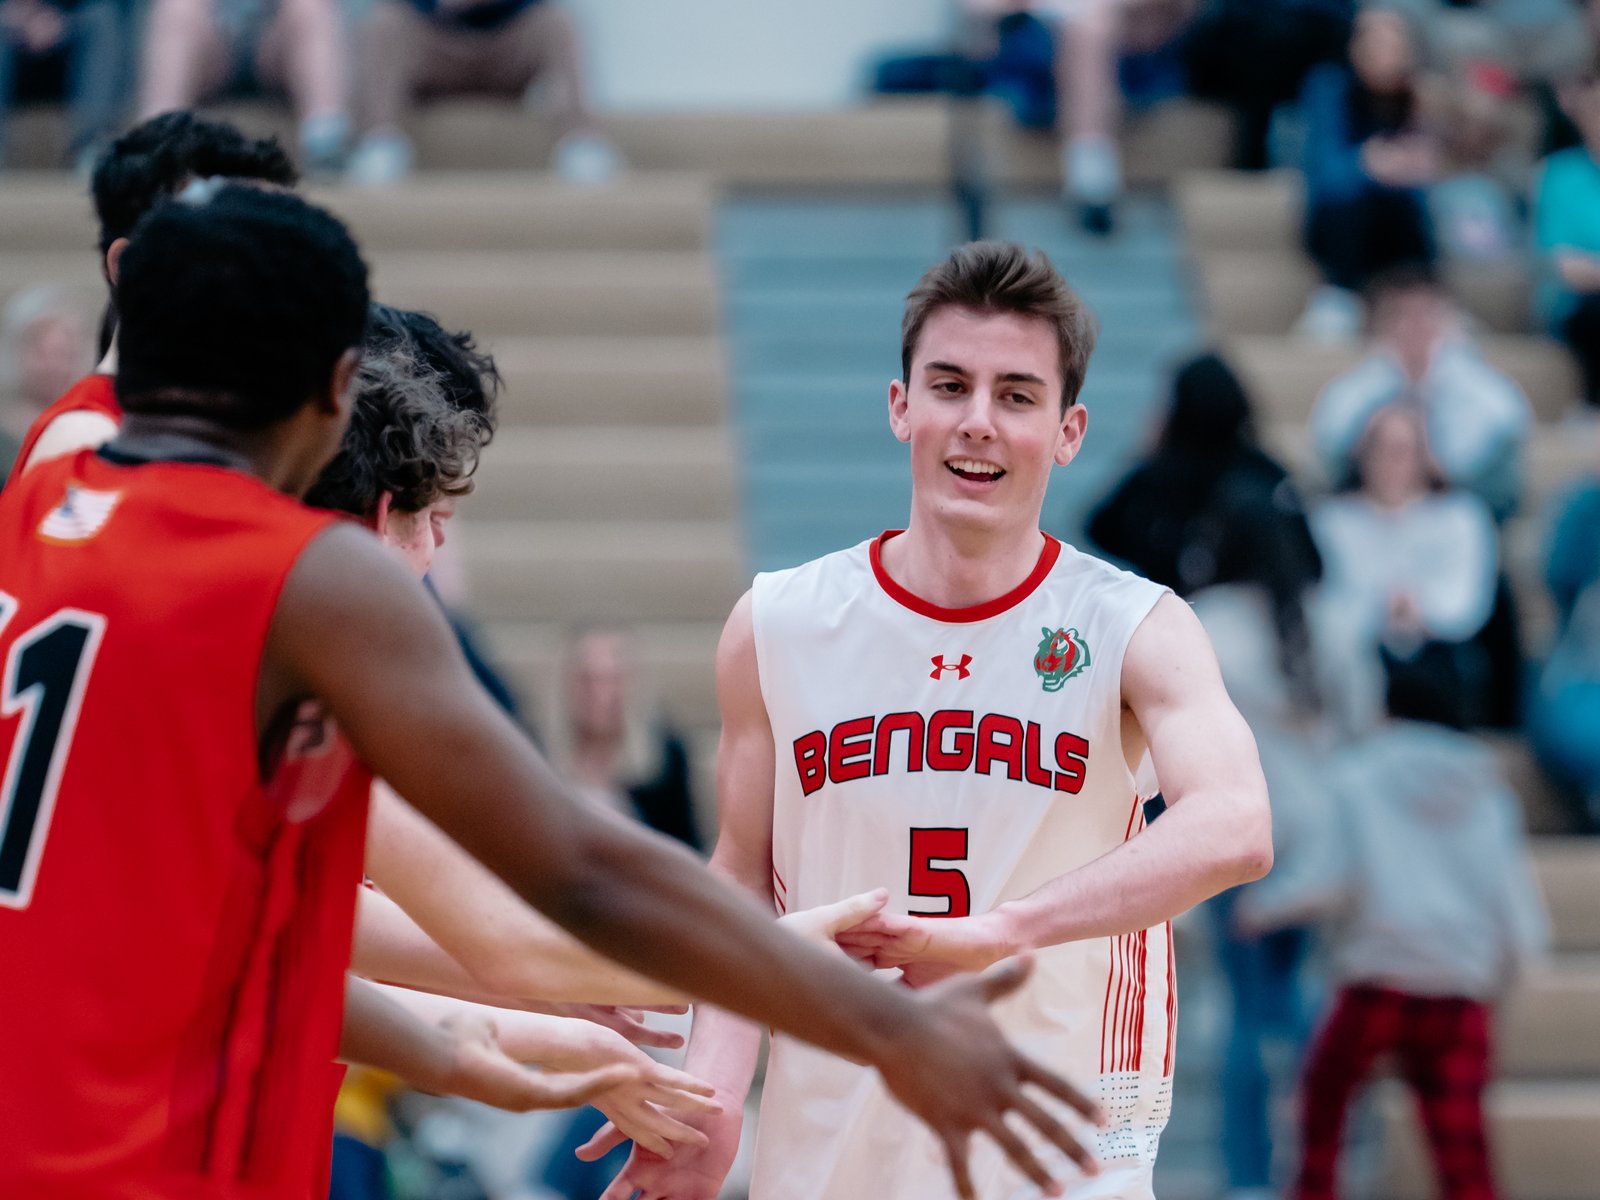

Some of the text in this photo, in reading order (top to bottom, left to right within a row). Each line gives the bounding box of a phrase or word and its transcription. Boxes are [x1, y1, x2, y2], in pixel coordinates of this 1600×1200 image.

[0, 588, 108, 911] 1
[793, 709, 1089, 797] BENGALS
[907, 827, 970, 918] 5
